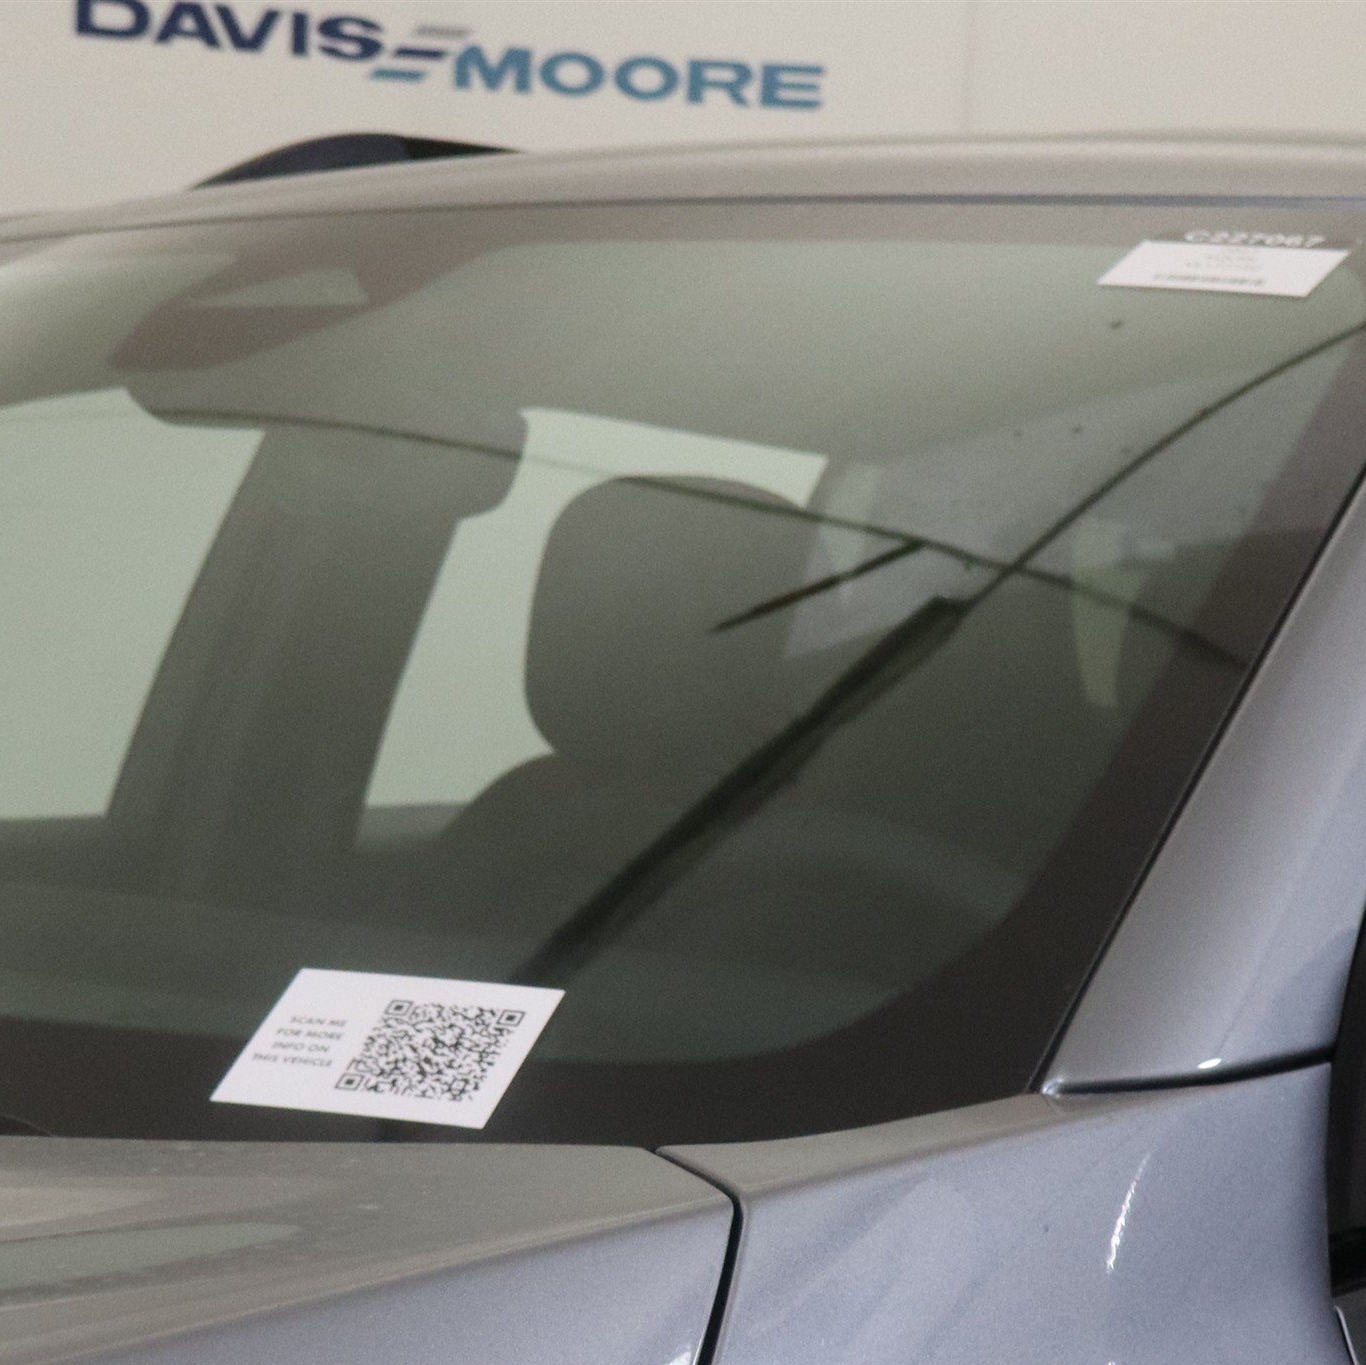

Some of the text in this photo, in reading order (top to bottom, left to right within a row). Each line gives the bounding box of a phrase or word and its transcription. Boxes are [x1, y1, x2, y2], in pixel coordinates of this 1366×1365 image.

[75, 0, 825, 111] DAVIS MOORE
[290, 1016, 346, 1028] SCAN ME
[276, 1028, 342, 1041] FOR MORE
[273, 1040, 330, 1053] INFO ON
[253, 1054, 333, 1068] THIS VEHICLE
